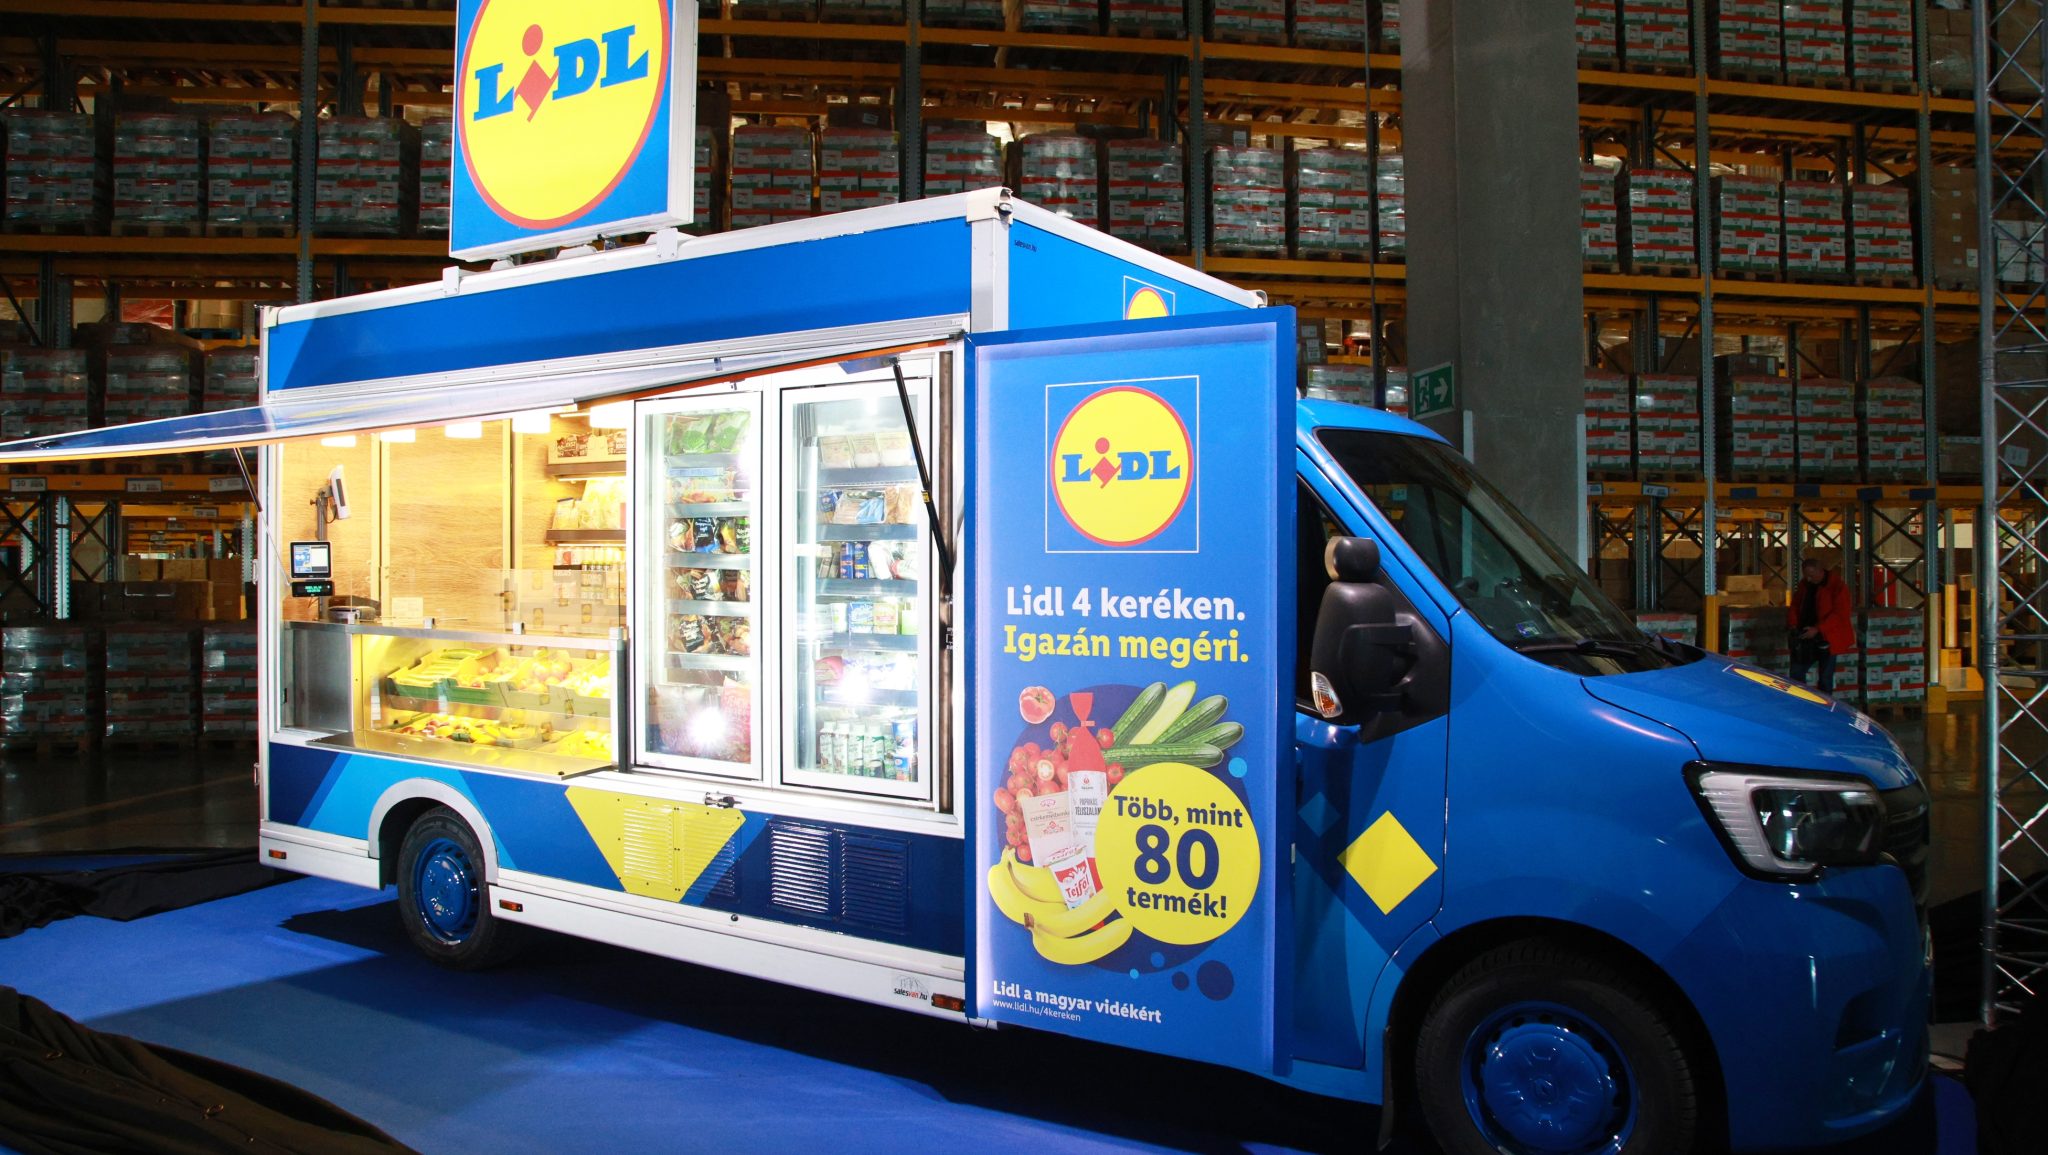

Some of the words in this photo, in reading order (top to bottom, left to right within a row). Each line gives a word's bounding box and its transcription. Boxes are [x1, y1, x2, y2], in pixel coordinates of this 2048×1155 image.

[1007, 584, 1065, 617] Lidl
[1071, 587, 1092, 617] 4
[1100, 587, 1246, 621] keréken.
[1003, 624, 1110, 662] Igazán
[1118, 628, 1249, 669] megéri.
[1113, 795, 1180, 826] Több,
[1186, 802, 1243, 828] mint
[1134, 824, 1220, 891] 80
[1126, 886, 1227, 919] termék!
[893, 987, 928, 1001] salesvan.hu
[992, 999, 1081, 1022] www.lidl.hu/4kereken
[993, 979, 1021, 999] Lidl
[1023, 992, 1033, 1001] a
[1035, 990, 1092, 1011] magyar
[1095, 998, 1162, 1024] vidékért
